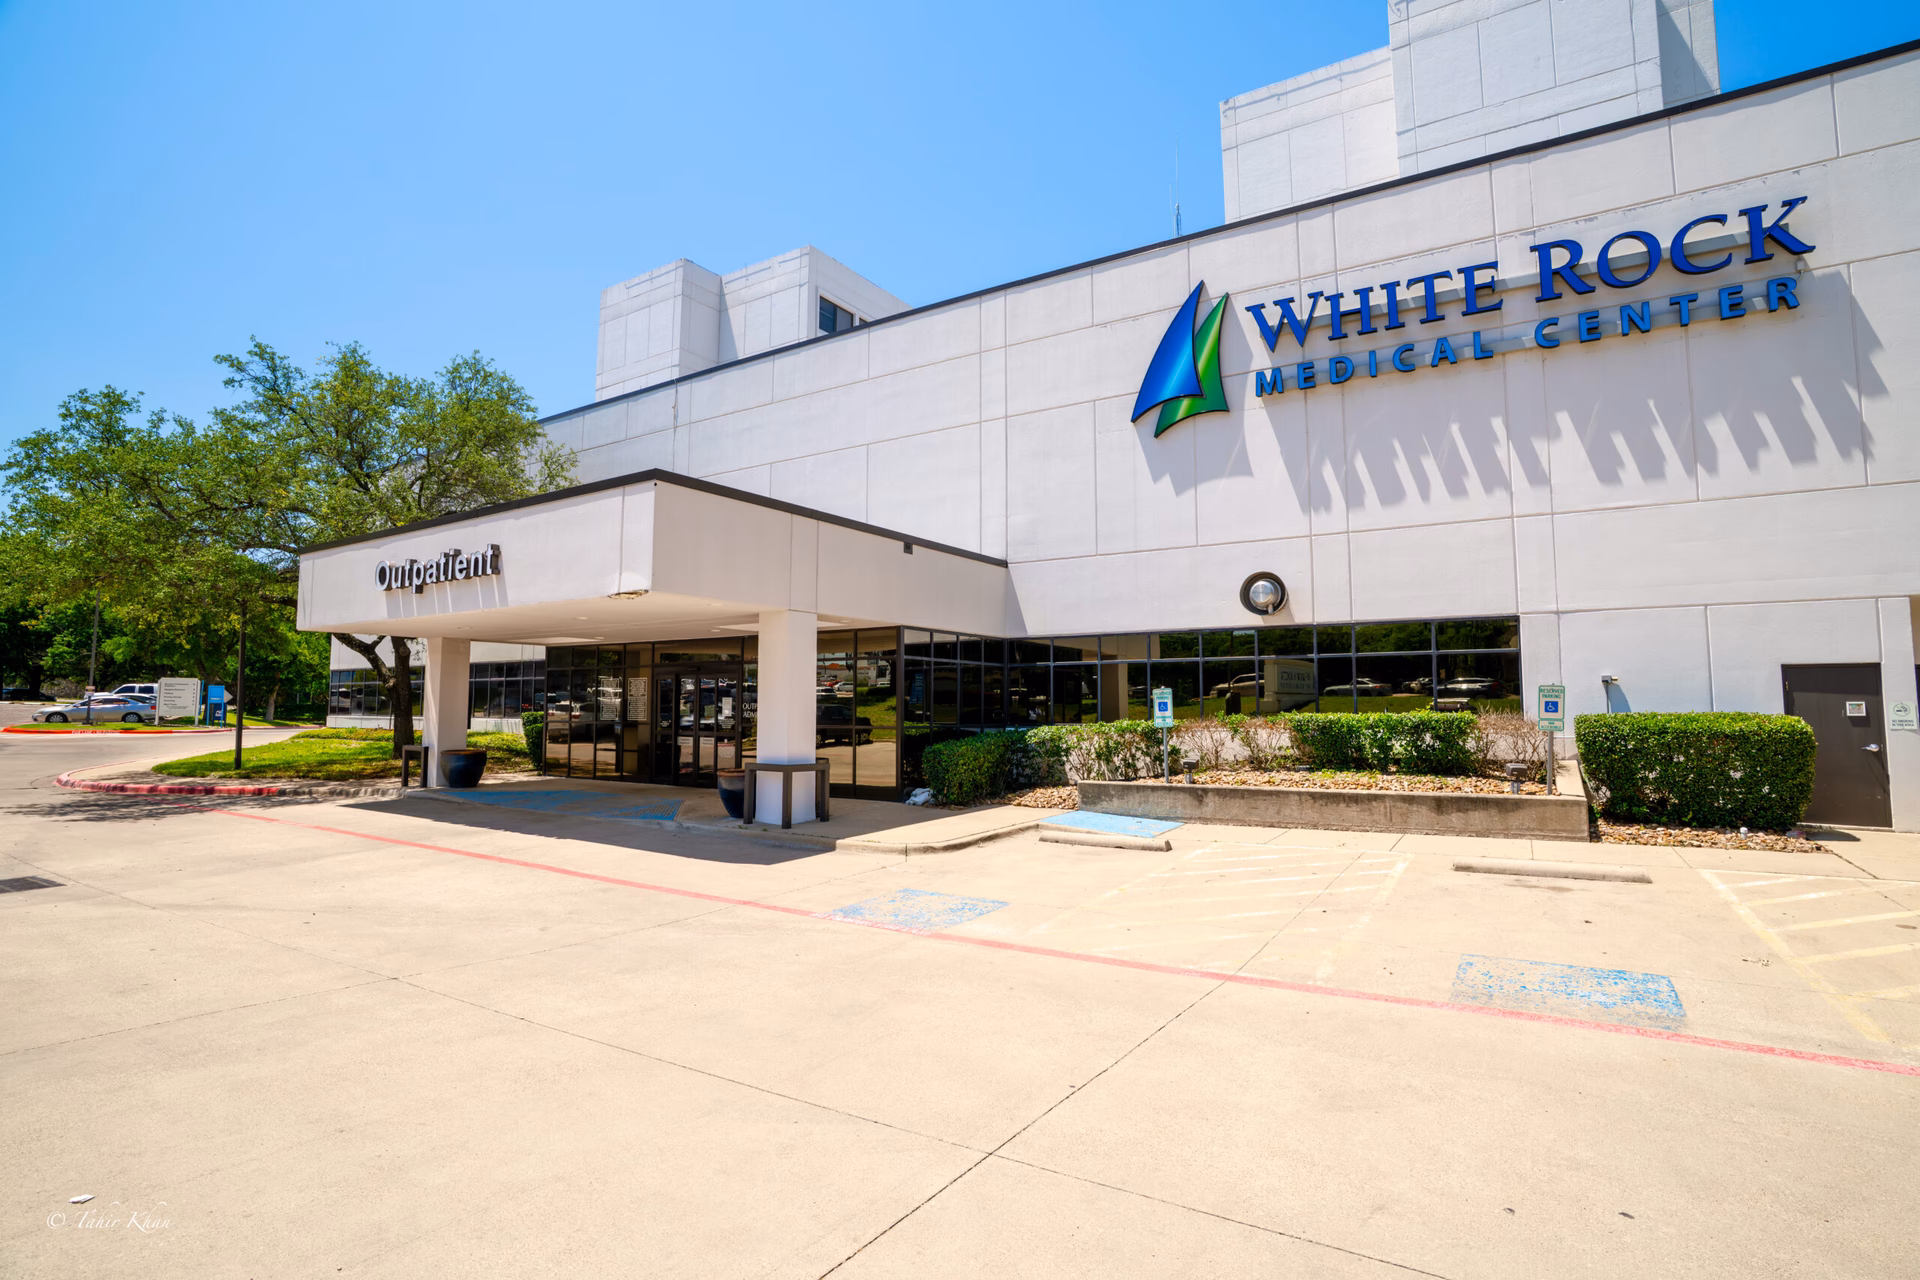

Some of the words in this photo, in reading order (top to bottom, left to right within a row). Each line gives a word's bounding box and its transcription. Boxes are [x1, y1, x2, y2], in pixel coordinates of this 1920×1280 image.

[1245, 260, 1503, 353] WHITE
[1529, 196, 1816, 303] ROCK
[1255, 331, 1494, 397] MEDICAL
[1534, 277, 1800, 349] CENTER
[375, 543, 500, 594] Outpatient
